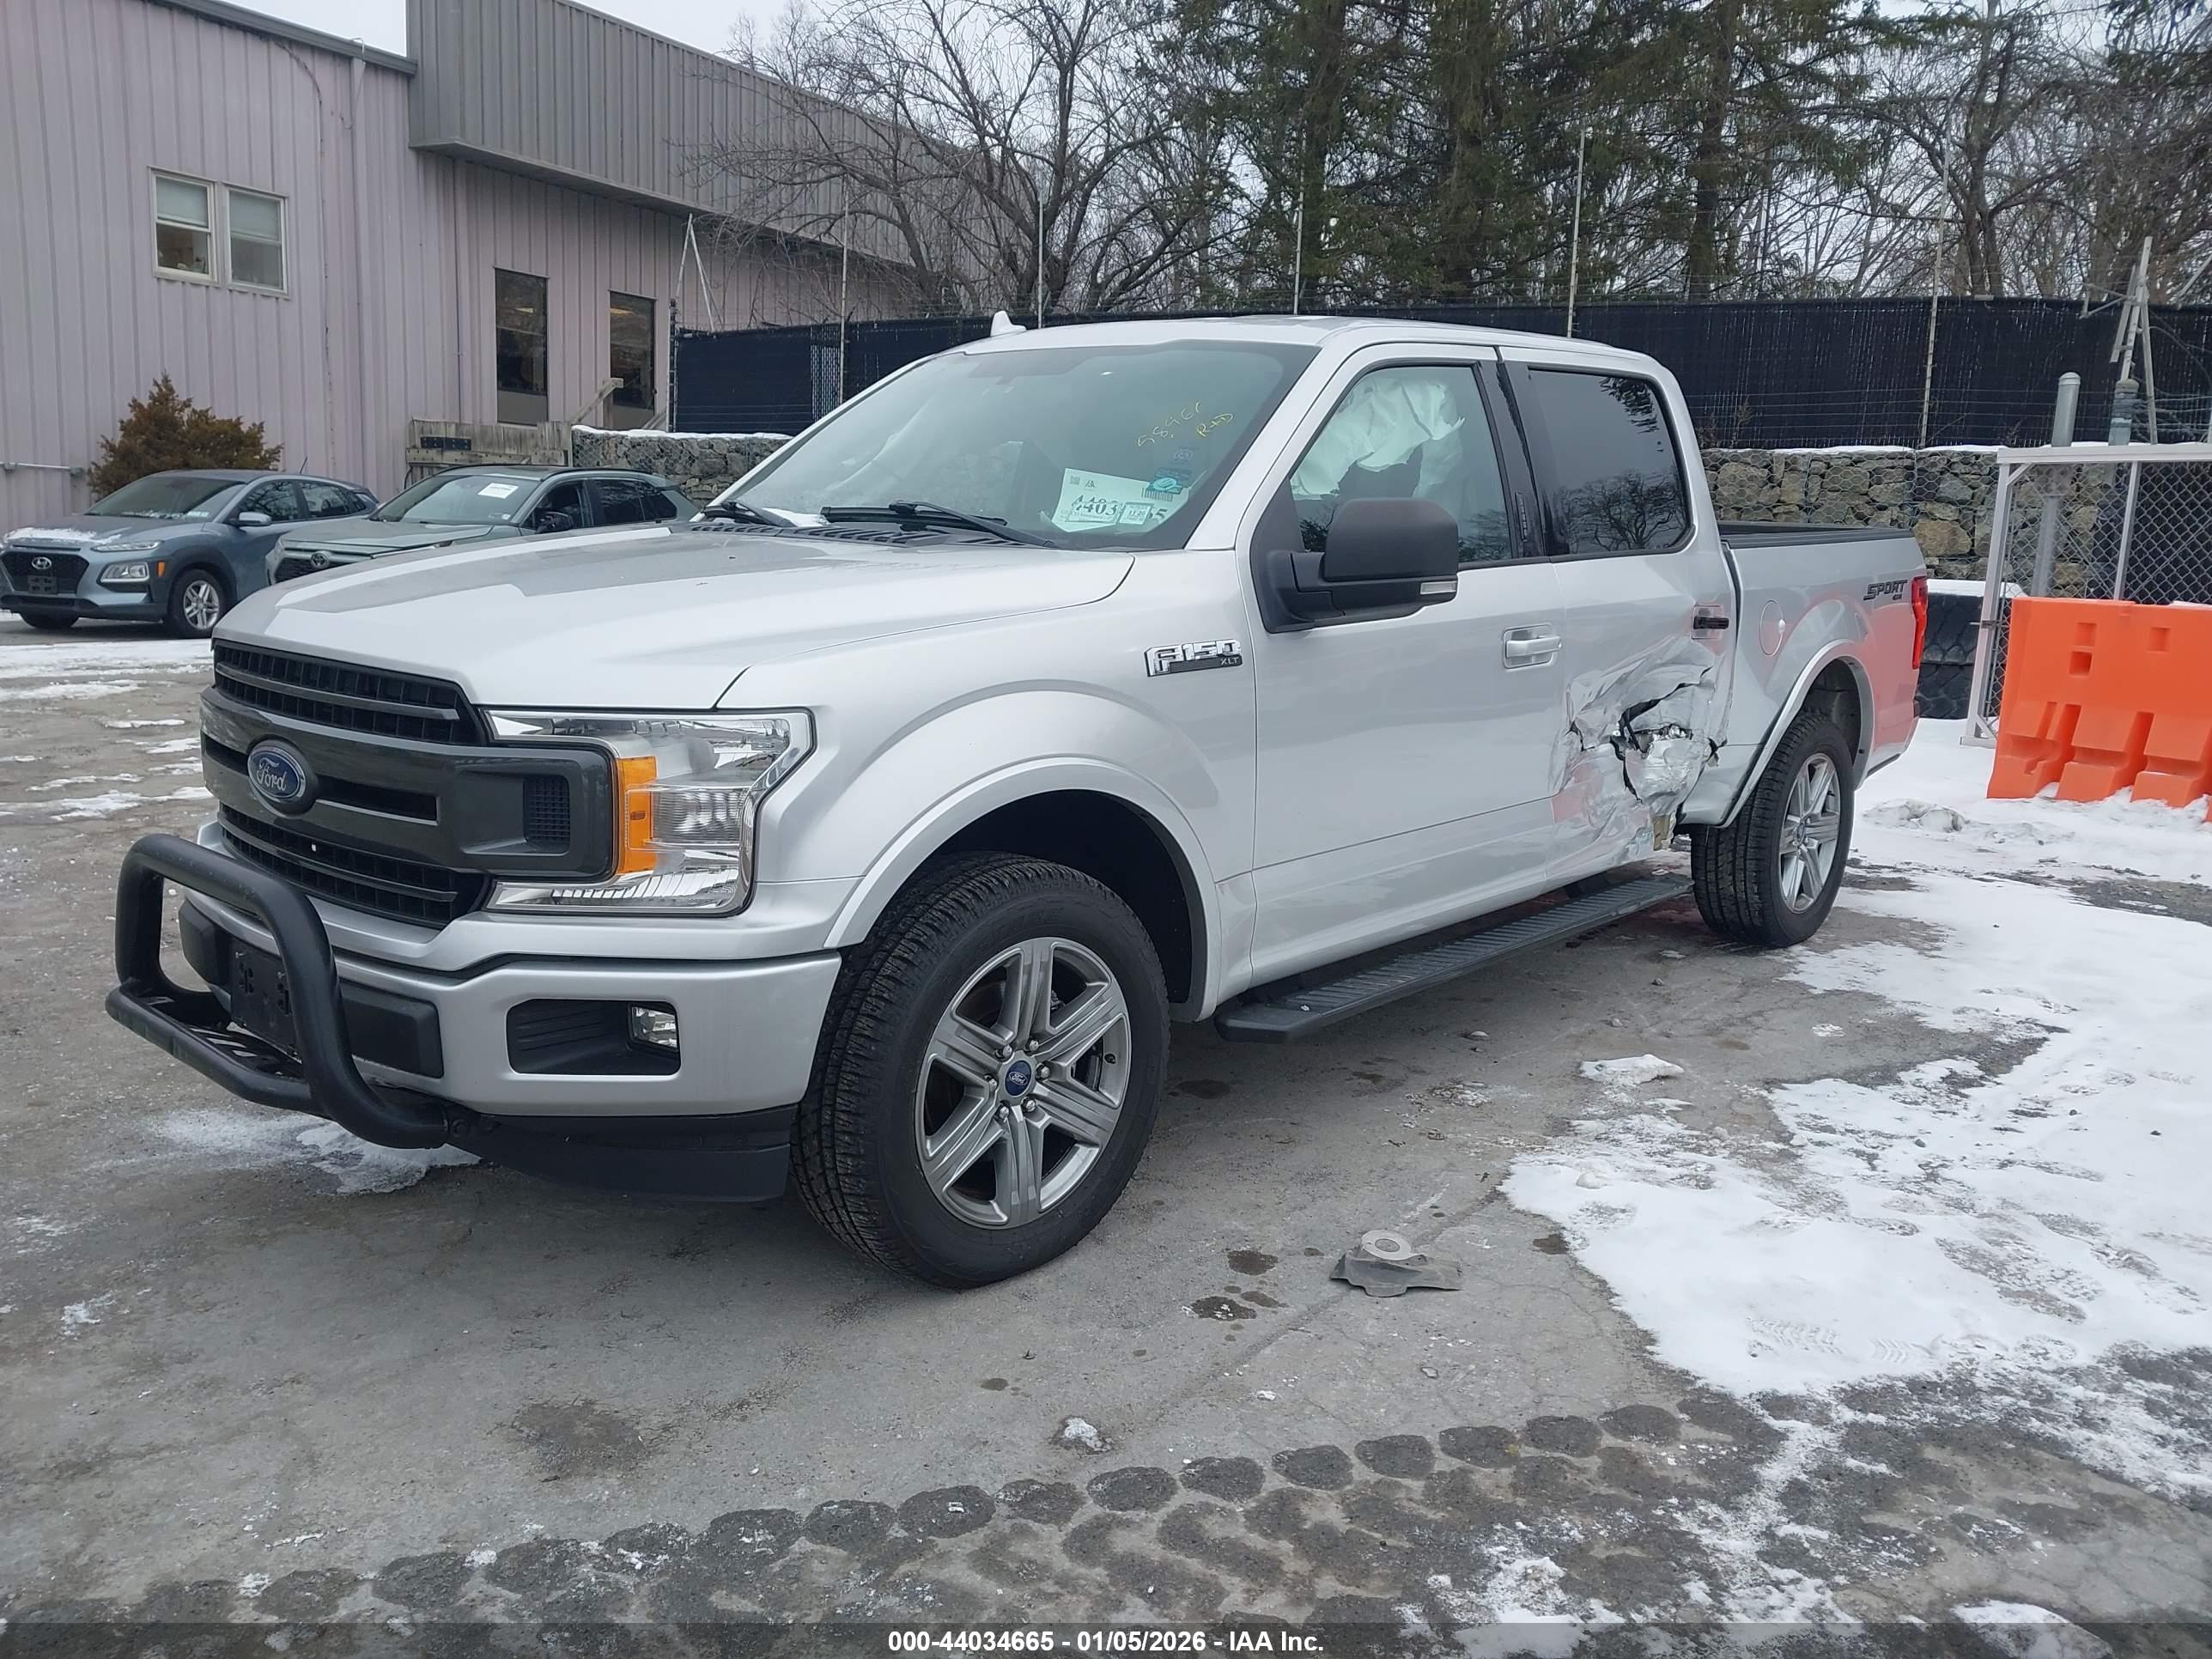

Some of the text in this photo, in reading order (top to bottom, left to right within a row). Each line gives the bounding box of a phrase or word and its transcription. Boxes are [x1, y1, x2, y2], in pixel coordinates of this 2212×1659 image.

[1863, 579, 1908, 601] SPORT
[1219, 656, 1239, 665] XLT
[257, 757, 289, 792] Ford
